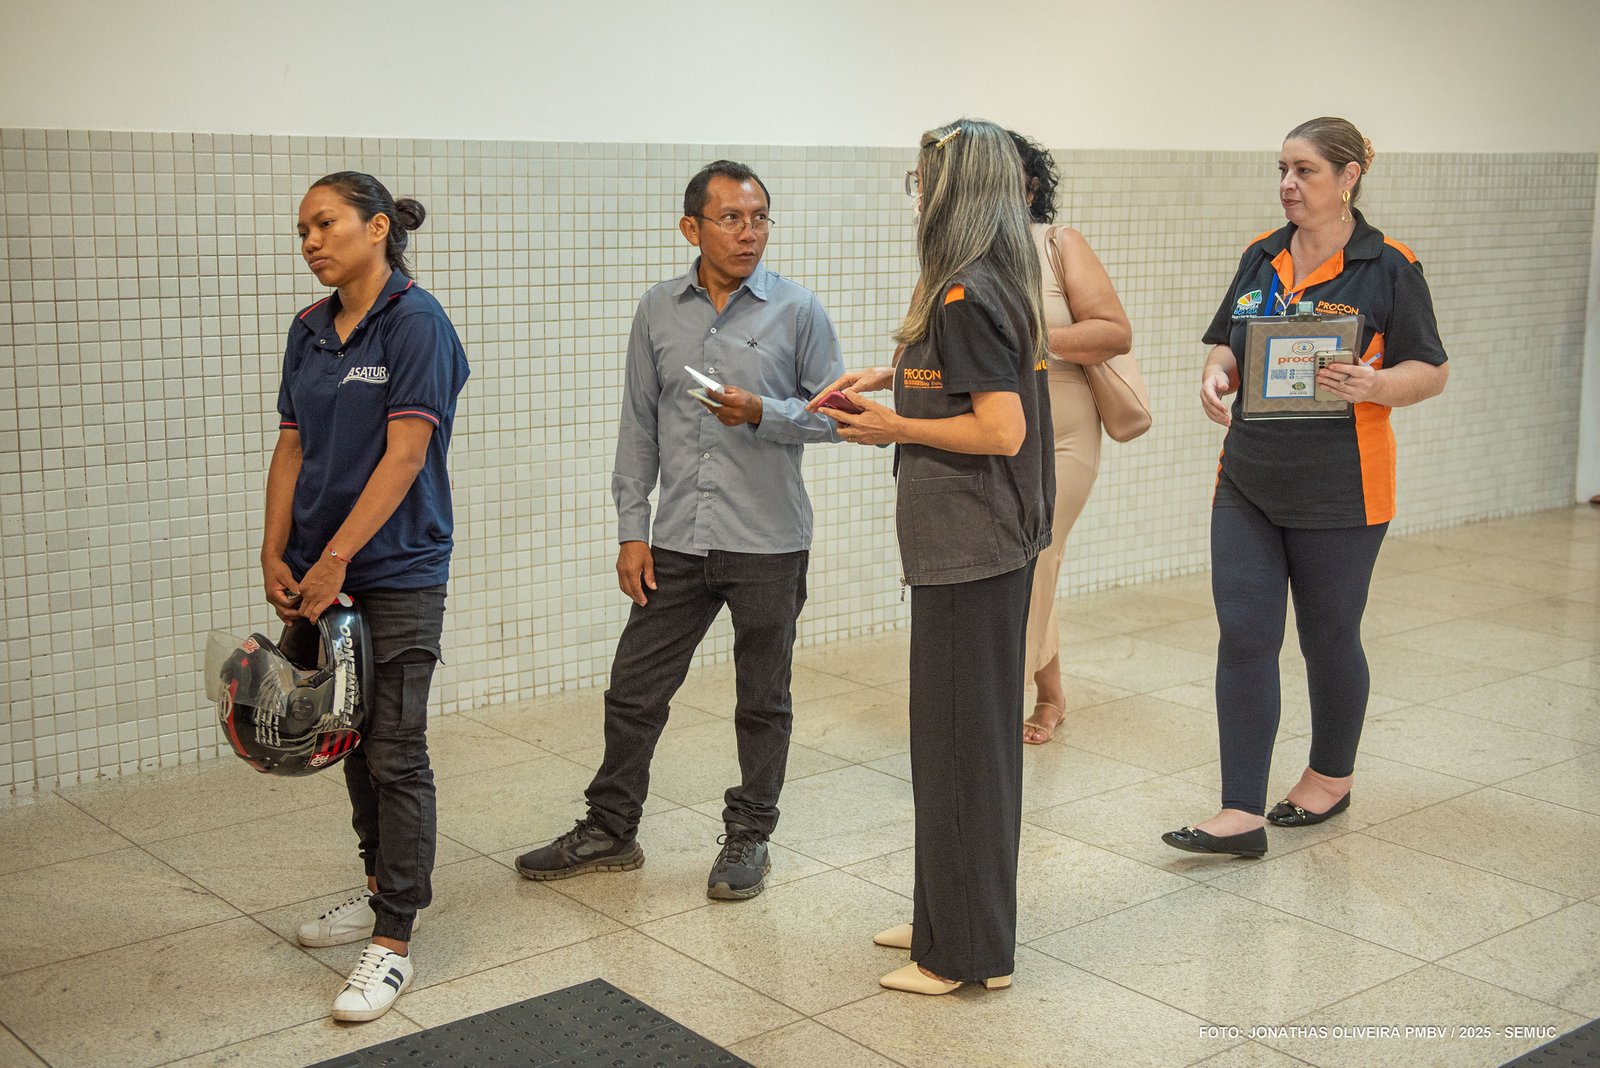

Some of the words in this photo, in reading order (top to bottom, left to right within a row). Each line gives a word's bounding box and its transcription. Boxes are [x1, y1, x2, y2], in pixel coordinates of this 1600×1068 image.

[1318, 301, 1359, 315] PROCON
[1278, 356, 1315, 365] proco
[346, 366, 387, 379] ASATUR
[903, 368, 942, 380] PROCON
[340, 624, 356, 727] FLAMENGO
